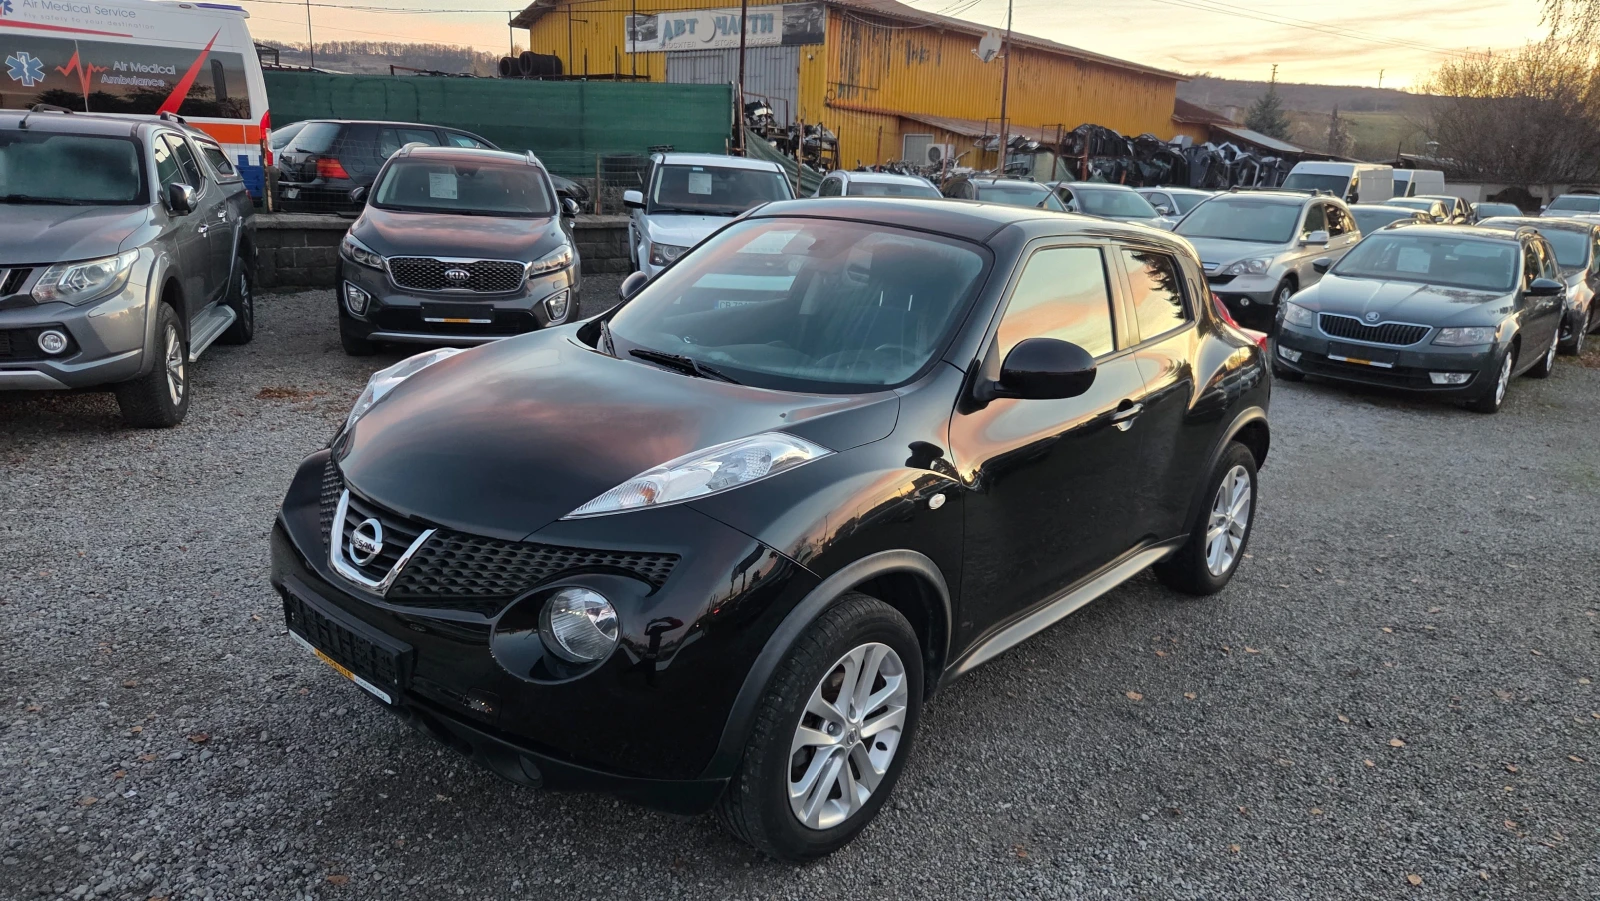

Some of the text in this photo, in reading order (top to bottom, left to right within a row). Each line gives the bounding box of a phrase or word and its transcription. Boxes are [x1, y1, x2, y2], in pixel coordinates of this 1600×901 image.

[22, 0, 136, 18] Air Medical Service
[40, 14, 68, 22] safely
[107, 20, 155, 30] destination
[745, 37, 781, 46] ПОТРЕБА
[112, 60, 176, 75] Air Medical
[100, 73, 165, 87] Ambulance
[448, 271, 466, 280] KIA
[352, 535, 376, 553] SSAN
[317, 650, 353, 679] AUTOELITE
